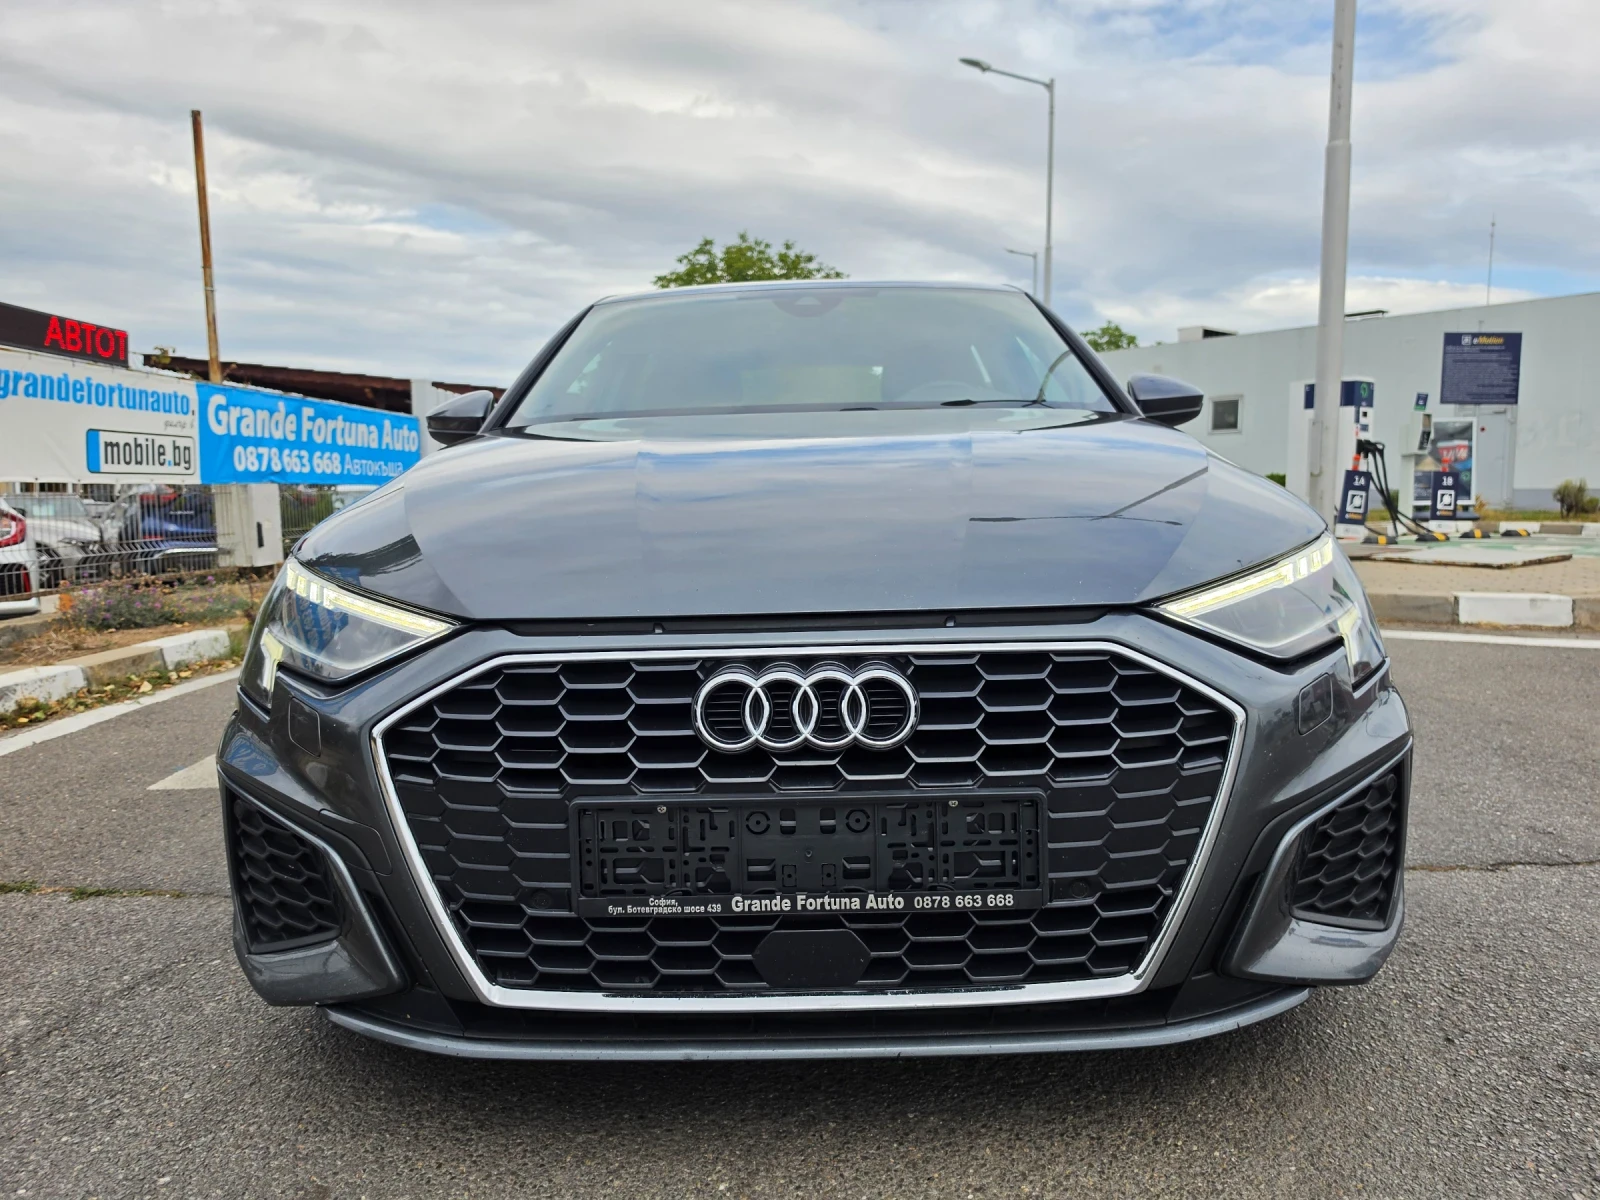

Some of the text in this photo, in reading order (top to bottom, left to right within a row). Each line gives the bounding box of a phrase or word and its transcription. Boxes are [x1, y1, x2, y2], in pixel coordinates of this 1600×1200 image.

[207, 394, 419, 452] Grande Fortuna Auto
[104, 437, 191, 470] mobile.bg
[233, 445, 282, 473] 0878
[282, 449, 310, 474] 663
[312, 451, 342, 475] 668
[608, 905, 625, 915] бул.
[683, 905, 705, 913] шосе
[707, 904, 722, 913] 439
[648, 897, 679, 909] София,
[731, 894, 1014, 912] Grande Fortuna Auto 0878 663 668
